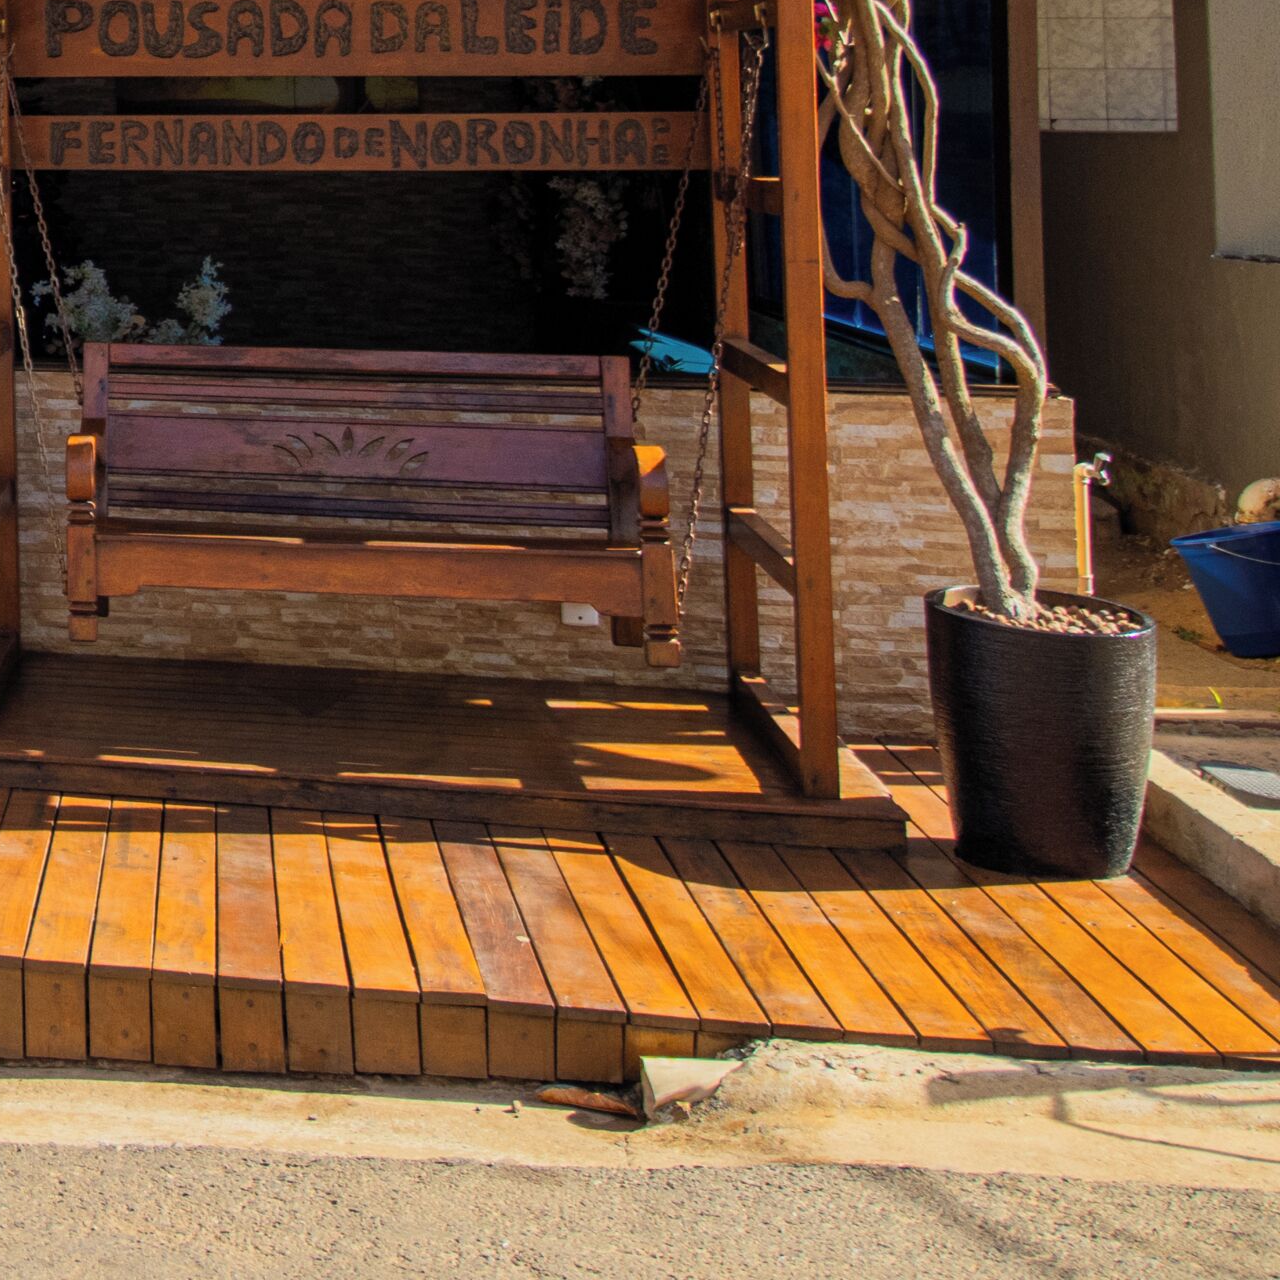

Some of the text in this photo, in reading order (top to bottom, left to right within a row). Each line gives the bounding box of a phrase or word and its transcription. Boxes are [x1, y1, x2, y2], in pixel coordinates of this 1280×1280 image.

[369, 0, 451, 54] DA
[48, 117, 327, 168] FERNANDO
[334, 125, 385, 158] DE
[390, 116, 648, 169] NORONHA
